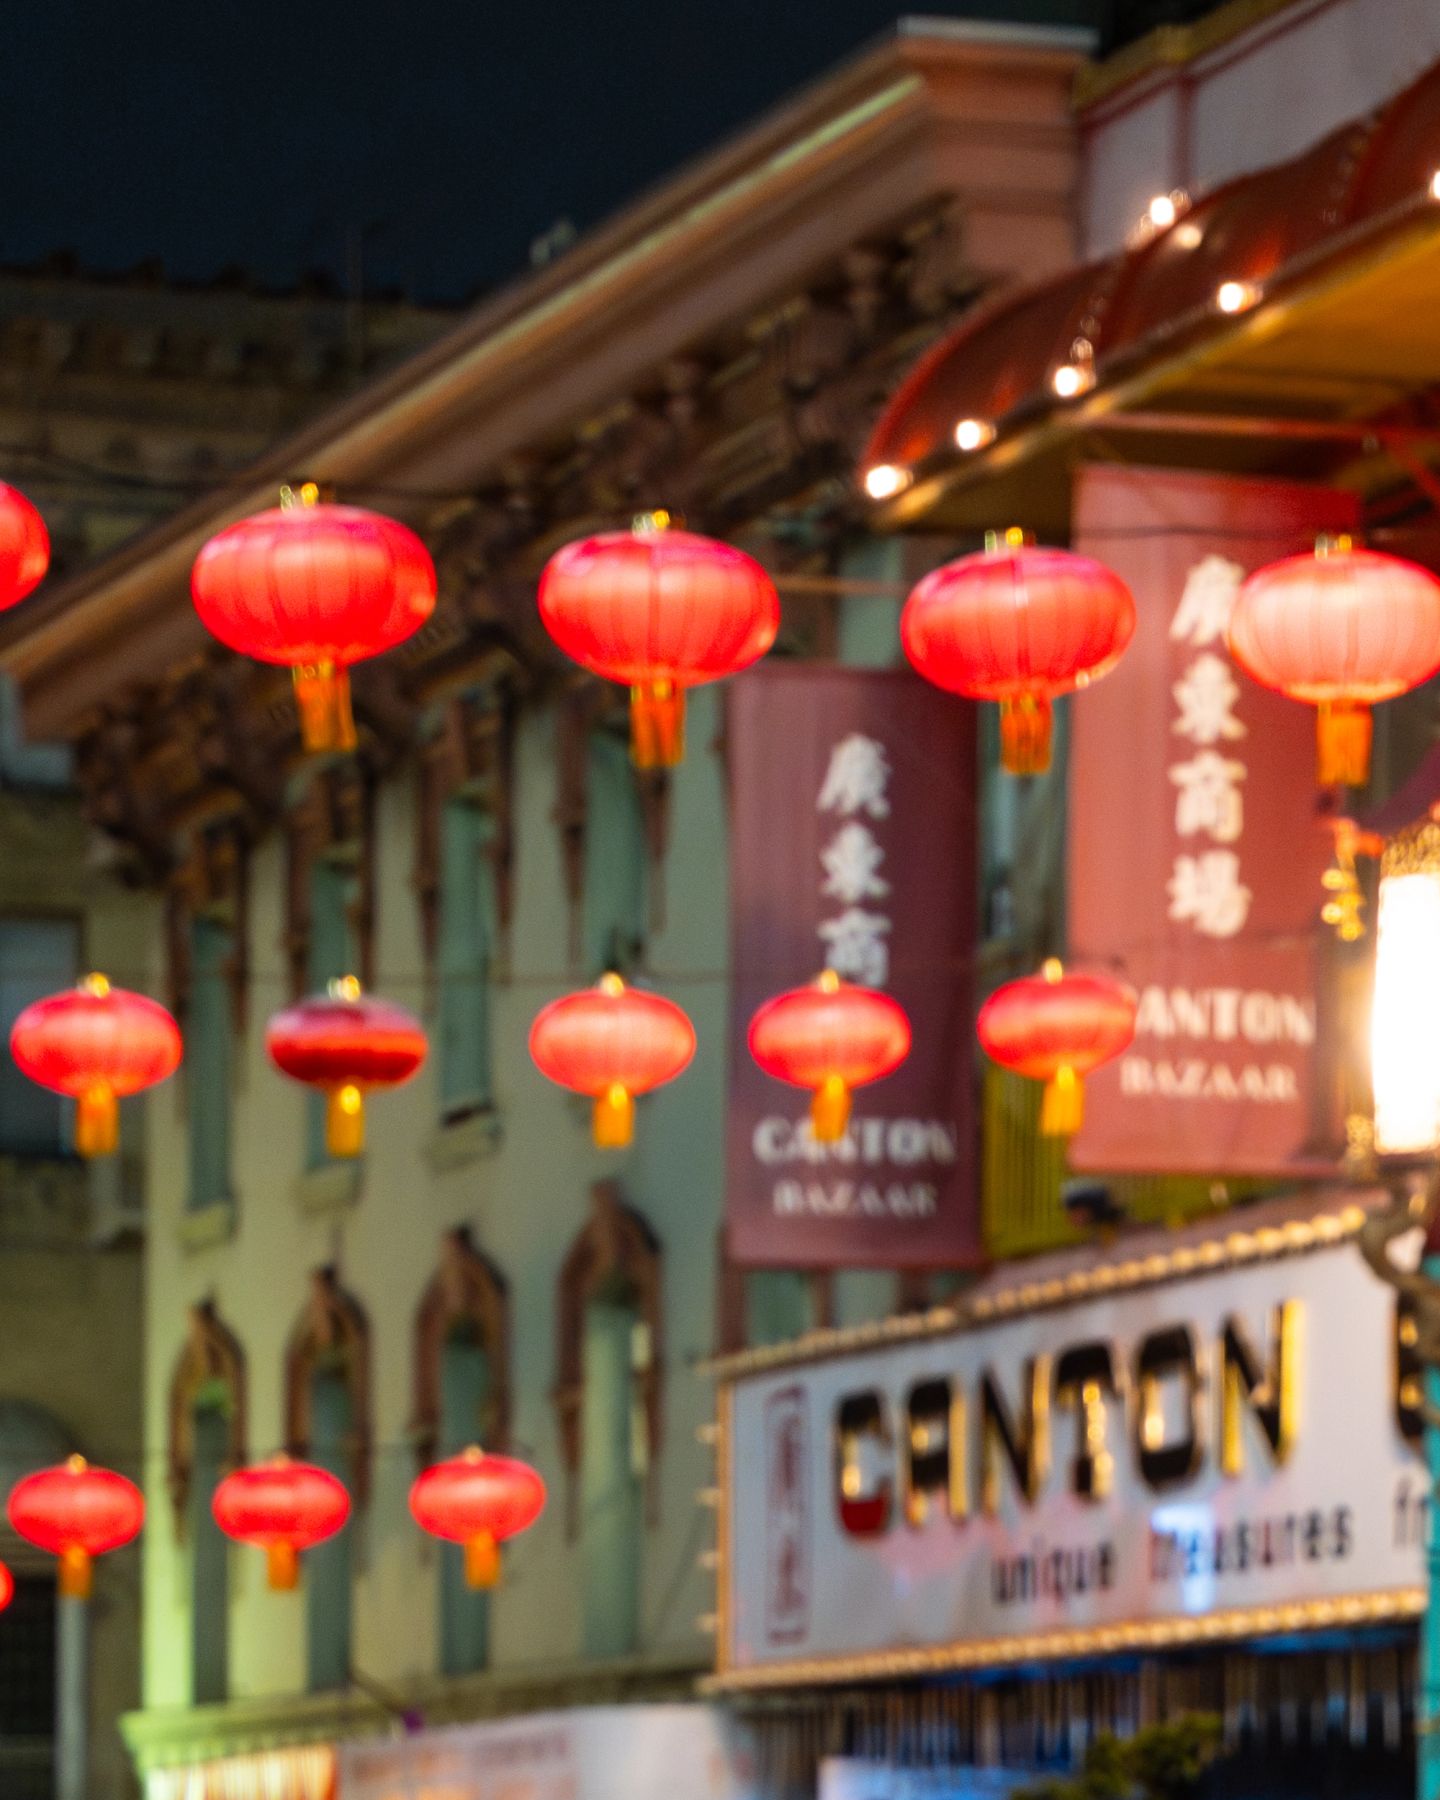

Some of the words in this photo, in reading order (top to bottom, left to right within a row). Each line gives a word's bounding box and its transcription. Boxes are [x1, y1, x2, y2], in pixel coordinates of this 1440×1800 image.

[1134, 985, 1317, 1046] ANTON
[1119, 1056, 1299, 1102] BAZAAR
[773, 1180, 938, 1217] BAZAAR
[834, 1297, 1304, 1541] CANTON
[991, 1540, 1112, 1606] unique
